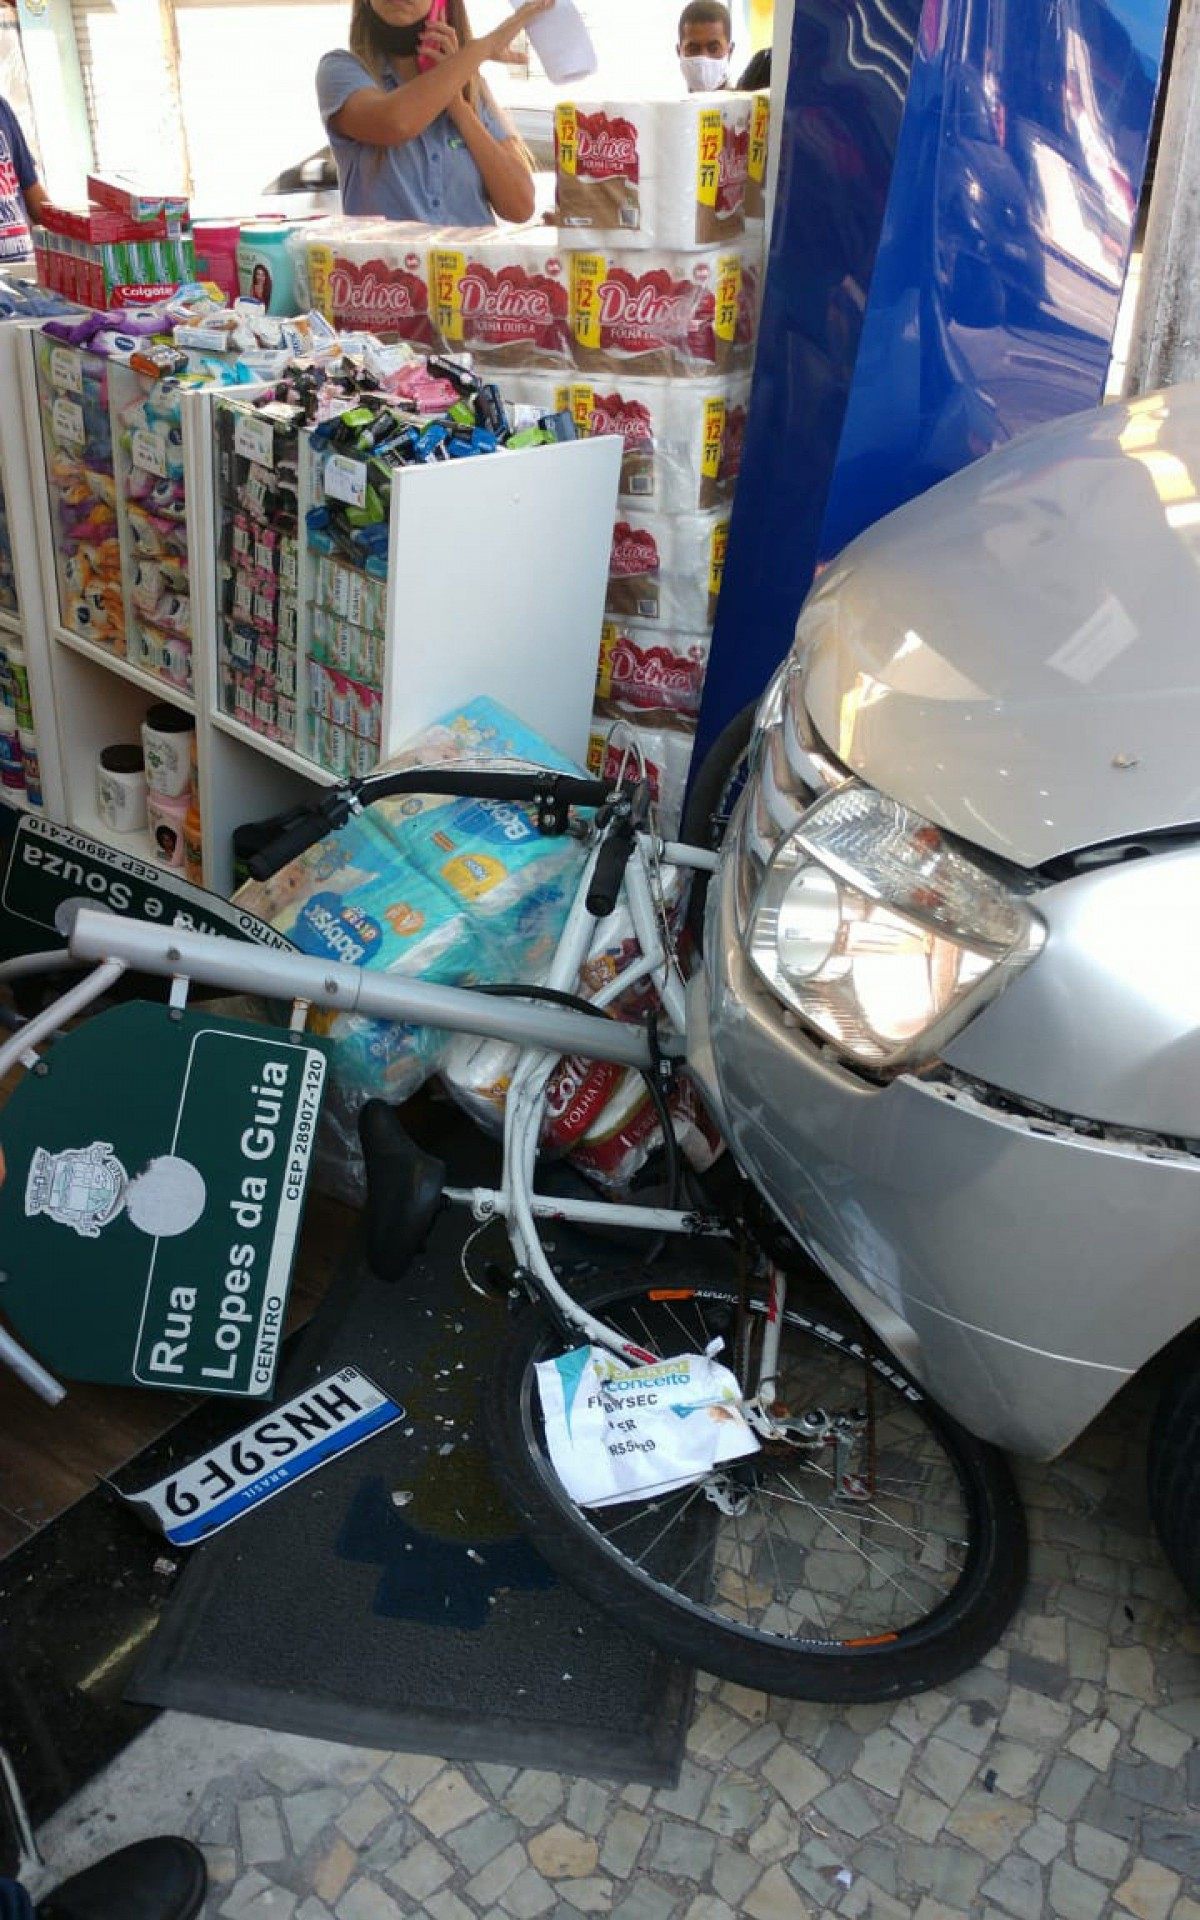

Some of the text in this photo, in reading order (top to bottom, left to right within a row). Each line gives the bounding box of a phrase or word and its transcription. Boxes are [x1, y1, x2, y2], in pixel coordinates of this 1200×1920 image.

[578, 130, 630, 158] Deluxe
[701, 142, 718, 160] 12
[701, 171, 714, 187] 11
[122, 286, 173, 299] Colgate
[330, 271, 410, 308] Deluxe
[459, 276, 549, 316] Deluxe
[576, 284, 592, 307] 12
[721, 285, 736, 301] 12
[28, 818, 160, 882] CEP 28907-410
[23, 844, 163, 917] e Souza
[562, 1089, 599, 1129] FOLHA
[286, 1059, 322, 1201] CEP 28907-120
[201, 1061, 289, 1379] Lopes da Guia
[149, 1285, 198, 1373] Rua
[254, 1296, 281, 1382] CENTRO
[336, 1367, 358, 1384] BR
[165, 1383, 362, 1517] HNS9F9
[241, 1469, 291, 1499] BRASIL
